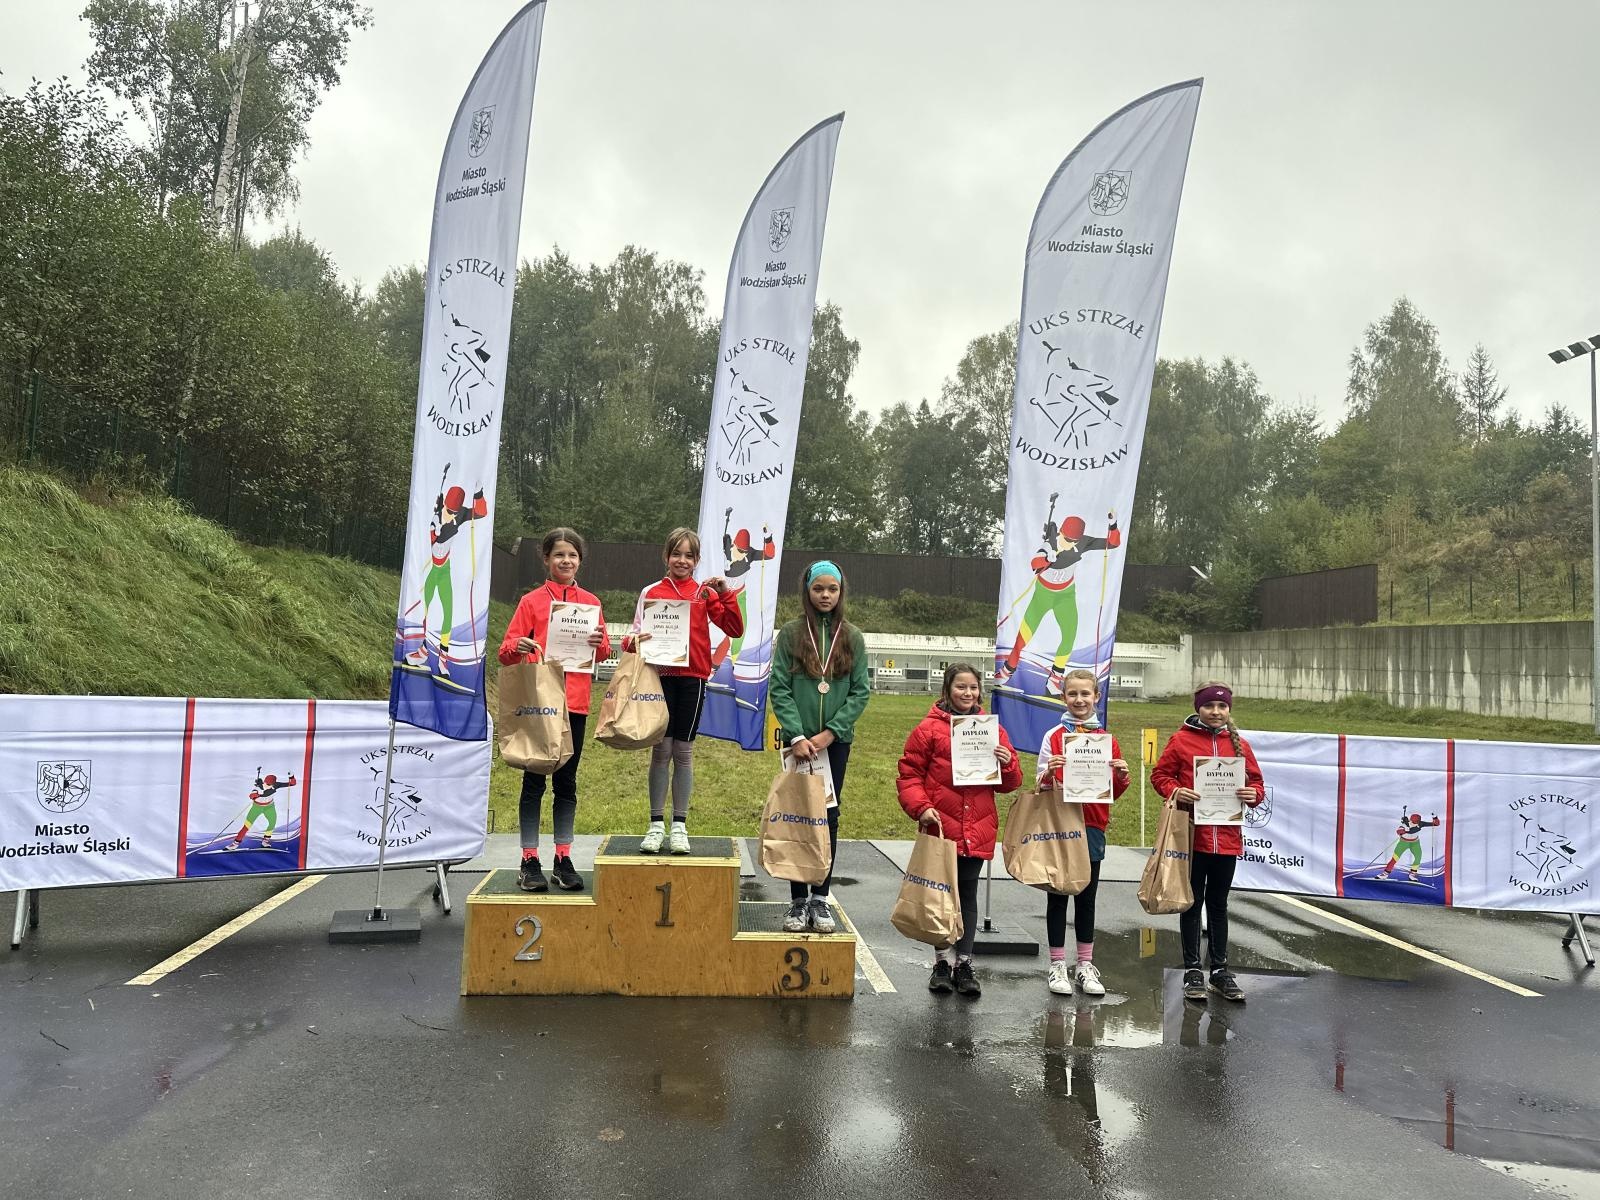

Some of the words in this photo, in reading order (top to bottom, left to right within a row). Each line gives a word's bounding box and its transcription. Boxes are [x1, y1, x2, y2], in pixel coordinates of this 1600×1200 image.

[462, 166, 487, 182] Miasto
[481, 177, 506, 197] Śląski
[1081, 223, 1124, 238] Miasto
[1048, 240, 1113, 254] Wodzisław
[1116, 240, 1154, 257] Śląski
[456, 258, 505, 288] STRZAŁ
[764, 260, 787, 273] Miasto
[740, 277, 781, 288] Wodzisław
[781, 273, 807, 288] Śląski
[1028, 310, 1070, 335] UKS
[1077, 308, 1145, 340] STRZAŁ
[724, 338, 748, 363] UKS
[752, 337, 796, 366] STRZAŁ
[1015, 436, 1128, 471] WODZISŁAW
[715, 461, 784, 486] ODZISŁAW
[561, 617, 589, 625] DYPLOM
[887, 660, 893, 669] 5
[774, 728, 781, 750] 9
[359, 747, 388, 765] UKS
[392, 745, 435, 762] STRZAŁ
[1147, 741, 1154, 764] 7
[1508, 795, 1536, 811] UKS
[1540, 793, 1587, 814] STRZAŁ
[34, 822, 90, 837] Miasto
[1032, 830, 1082, 841] DECATHLON
[83, 836, 131, 856] Śląski
[1242, 835, 1273, 849] iasto
[1268, 851, 1305, 869] Śląski
[1508, 874, 1589, 897] WODZISŁAW
[655, 881, 675, 927] 1
[514, 915, 544, 962] 2
[782, 946, 811, 992] 3
